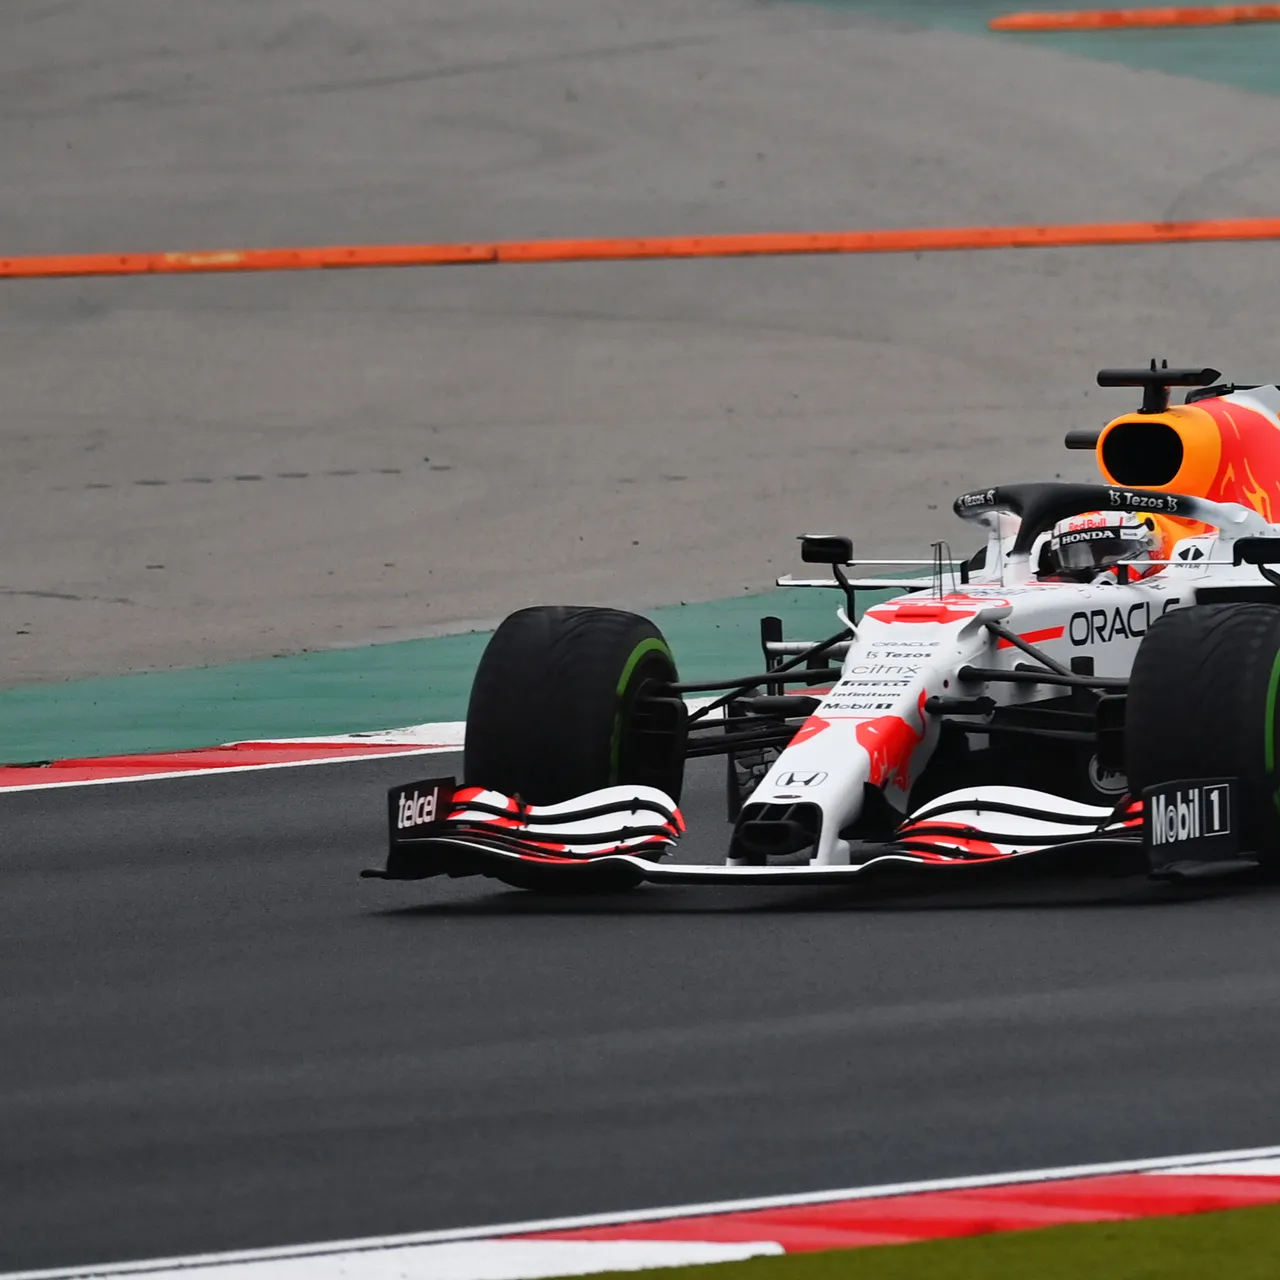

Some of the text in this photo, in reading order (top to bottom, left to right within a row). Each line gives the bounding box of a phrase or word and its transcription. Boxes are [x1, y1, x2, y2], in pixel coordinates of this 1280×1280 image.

[1123, 492, 1164, 508] Tezos
[1069, 517, 1107, 531] Red Bull
[1062, 530, 1116, 545] HONDA
[851, 663, 922, 675] citrix
[397, 786, 439, 829] telcel
[1152, 788, 1200, 846] Mobil
